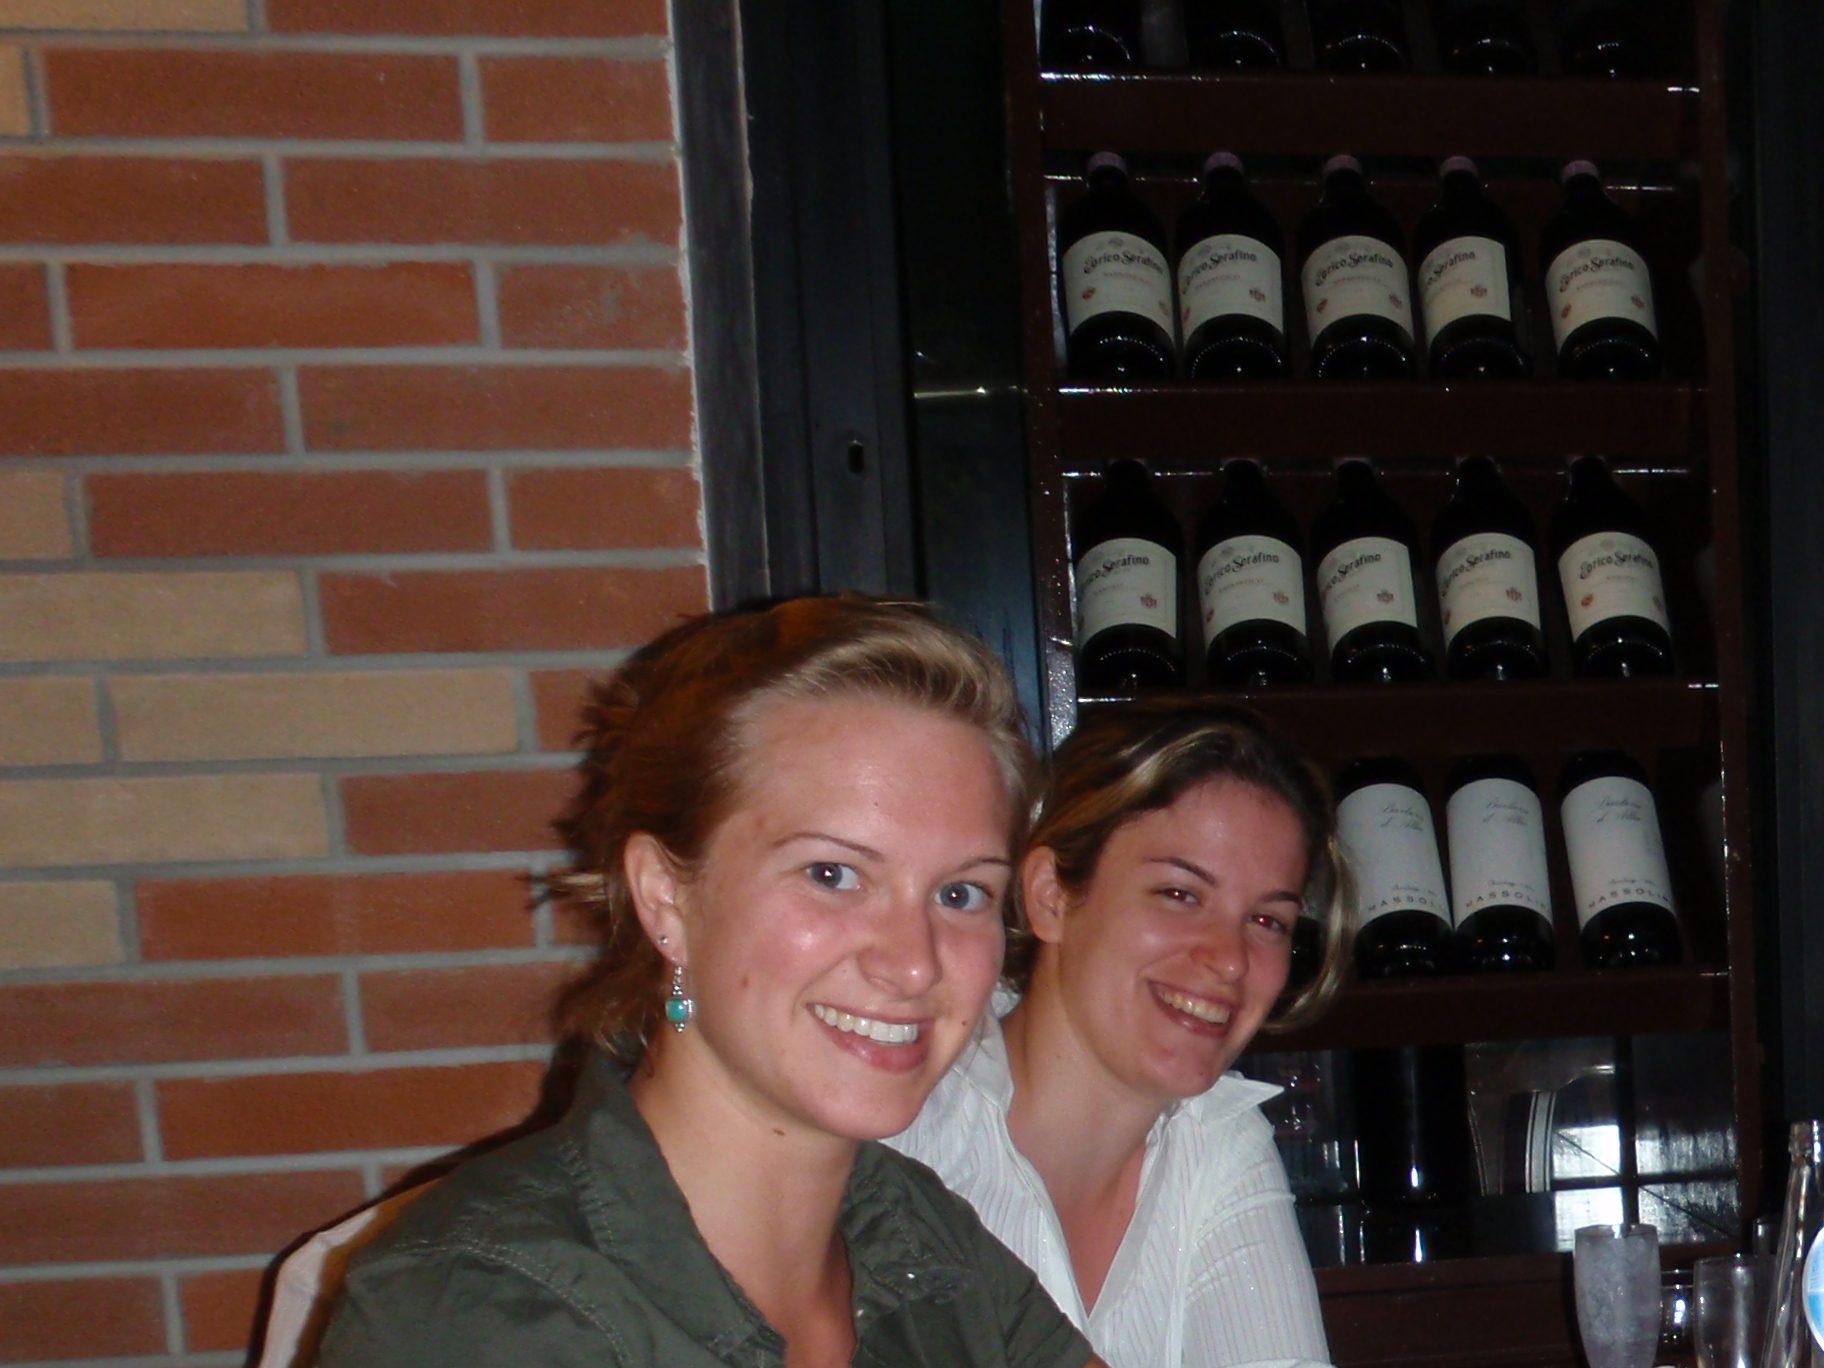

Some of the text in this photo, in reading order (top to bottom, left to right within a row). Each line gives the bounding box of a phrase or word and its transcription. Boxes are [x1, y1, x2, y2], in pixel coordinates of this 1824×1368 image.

[1208, 249, 1258, 271] Serafino
[1346, 252, 1394, 269] Serafino
[1589, 256, 1635, 273] Serafino
[1102, 554, 1150, 578] Serafino
[1231, 552, 1280, 573] Serafino
[1337, 554, 1381, 583] Serafino
[1465, 549, 1512, 573] Serafino
